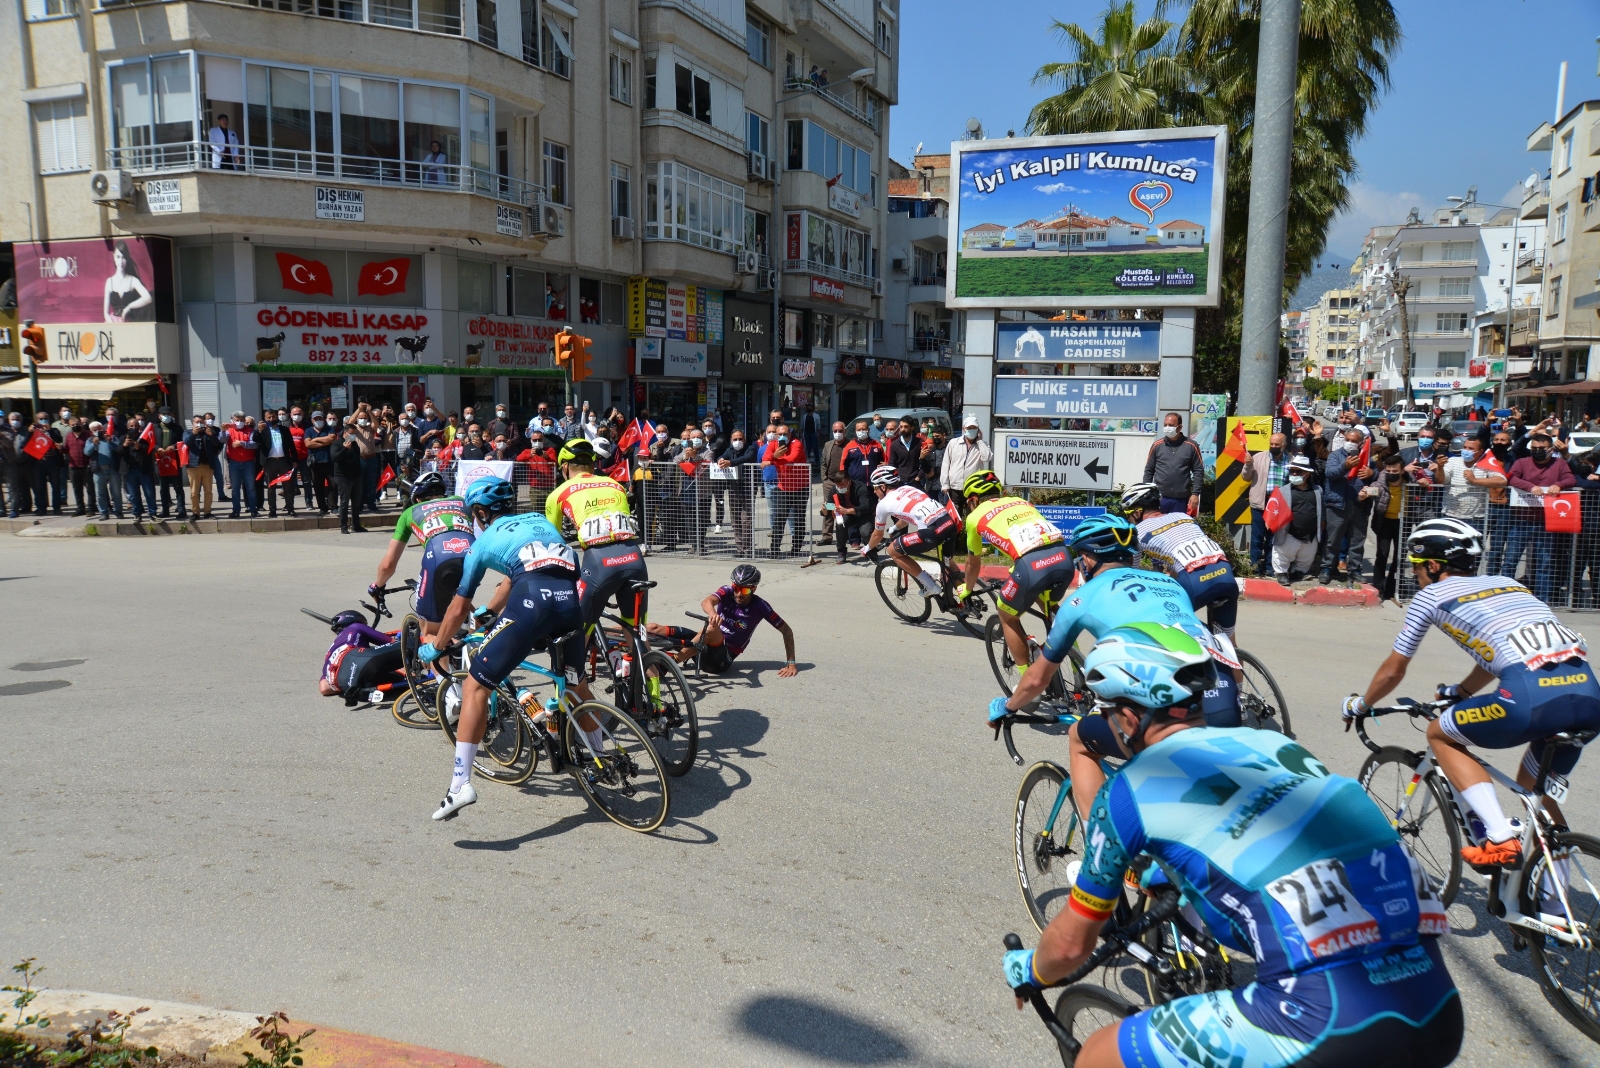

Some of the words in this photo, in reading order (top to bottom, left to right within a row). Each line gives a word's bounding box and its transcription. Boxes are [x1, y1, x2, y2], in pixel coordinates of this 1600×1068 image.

[973, 167, 1005, 194] İyi
[1010, 152, 1081, 181] Kalpli
[1088, 151, 1198, 183] Kumluca
[1140, 192, 1164, 201] AŞEVİ
[317, 203, 342, 211] BURHAN
[344, 204, 363, 213] YAZAR
[1115, 274, 1161, 282] KÖLEOĞLU
[1123, 268, 1153, 276] Mustafa
[257, 306, 358, 329] GÖDENELİ
[363, 313, 428, 331] KASAP
[468, 317, 529, 339] GÖDENELİ
[531, 325, 562, 341] KASA
[1050, 326, 1099, 338] HASAN
[1102, 327, 1142, 338] TUNA
[302, 333, 320, 346] ET
[322, 336, 339, 346] ve
[341, 333, 389, 347] TAVUK
[494, 339, 507, 351] ET
[519, 341, 547, 354] TAVUK
[1065, 338, 1126, 347] (BAŞPEHLİVAN)
[309, 350, 335, 362] 887
[340, 350, 358, 362] 23
[362, 351, 382, 363] 34
[670, 354, 680, 363] Türk
[680, 355, 697, 364] Telekom
[1063, 346, 1126, 358] CADDESİ
[499, 354, 514, 365] 887
[516, 355, 527, 365] 23
[528, 356, 538, 366] 34
[1021, 380, 1068, 396] FİNİKE
[1083, 384, 1138, 397] ELMALI
[1419, 381, 1452, 389] DenizBank
[1055, 398, 1109, 414] MUĞLA
[1020, 439, 1045, 448] ANTALYA
[1045, 438, 1077, 449] BÜYÜKŞEHİR
[1077, 439, 1109, 449] BELEDİYESİ
[1008, 451, 1054, 465] RADYOFAR
[1056, 453, 1081, 466] KOYU
[1020, 468, 1041, 484] AİLE
[1041, 471, 1067, 486] PLAJI
[584, 497, 616, 509] Adeps
[426, 516, 441, 529] 31
[1006, 510, 1034, 525] Adeps
[584, 518, 600, 537] 77
[525, 543, 536, 558] 7
[558, 543, 566, 556] 7
[1177, 540, 1204, 562] 101
[606, 554, 636, 565] BINGOAL
[1035, 554, 1063, 569] BINGOAL
[1199, 567, 1227, 582] DELKO
[1440, 622, 1496, 663] DELKO
[1506, 621, 1552, 657] 107
[1538, 673, 1588, 687] DELKO
[1203, 688, 1219, 698] ECH
[1454, 703, 1507, 725] DELKO
[1545, 779, 1565, 799] 107
